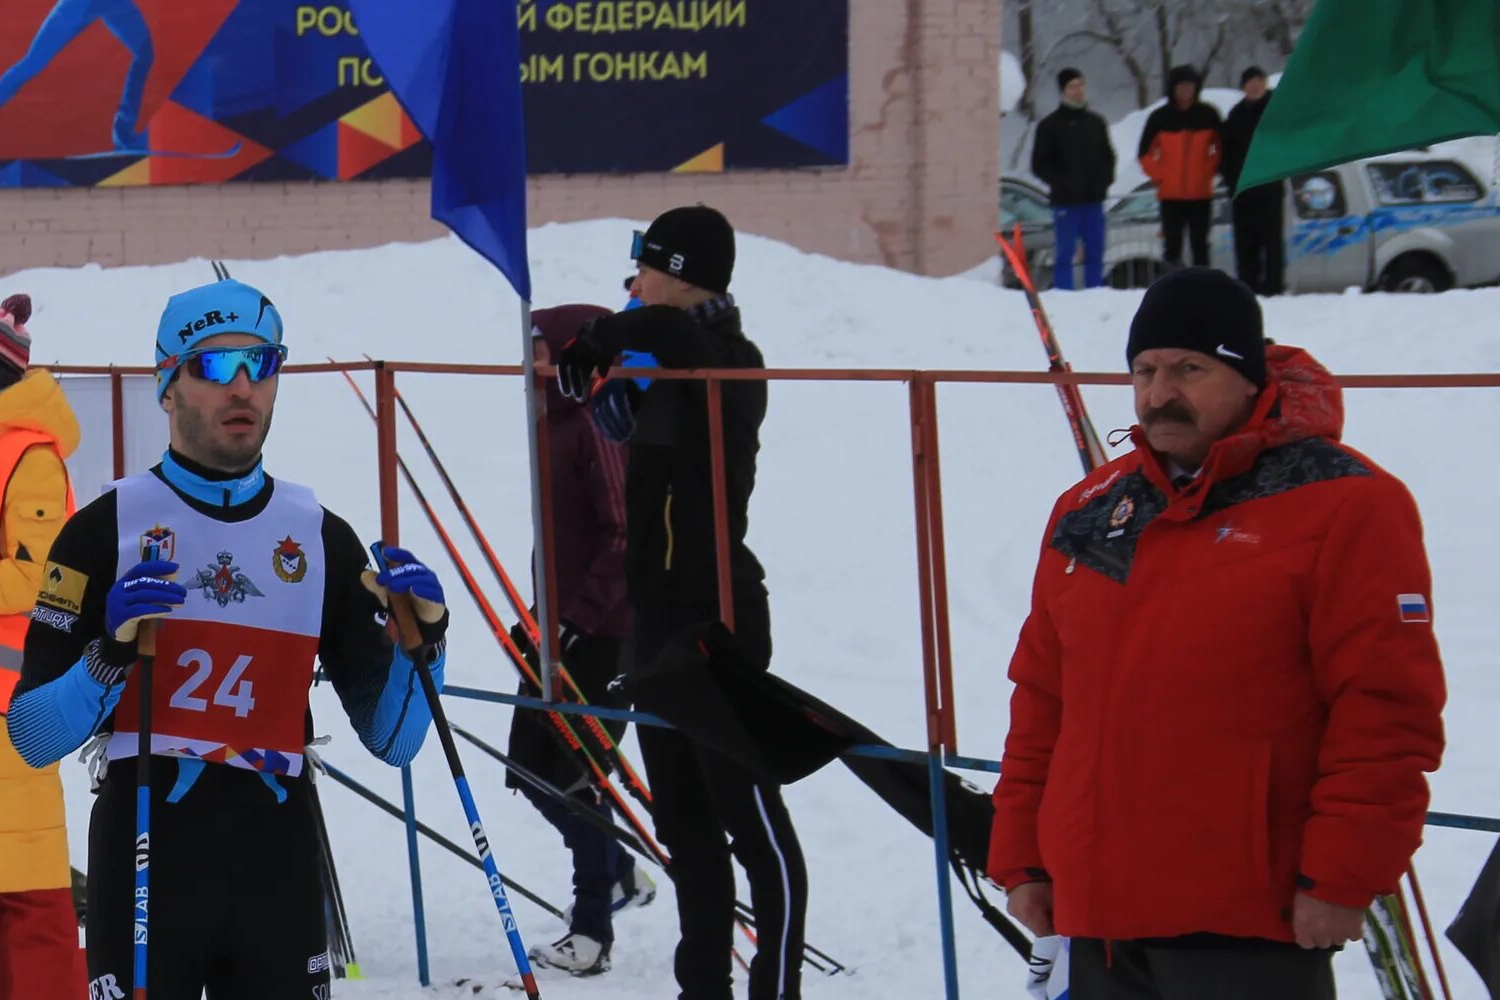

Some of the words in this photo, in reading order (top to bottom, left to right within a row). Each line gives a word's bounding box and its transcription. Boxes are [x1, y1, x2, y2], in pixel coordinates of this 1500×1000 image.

[296, 5, 359, 37] РОС
[546, 0, 747, 34] ФЕДЕРАЦИИ
[519, 53, 564, 83] ЫМ
[573, 50, 708, 82] ГОНКАМ
[169, 648, 255, 718] 24
